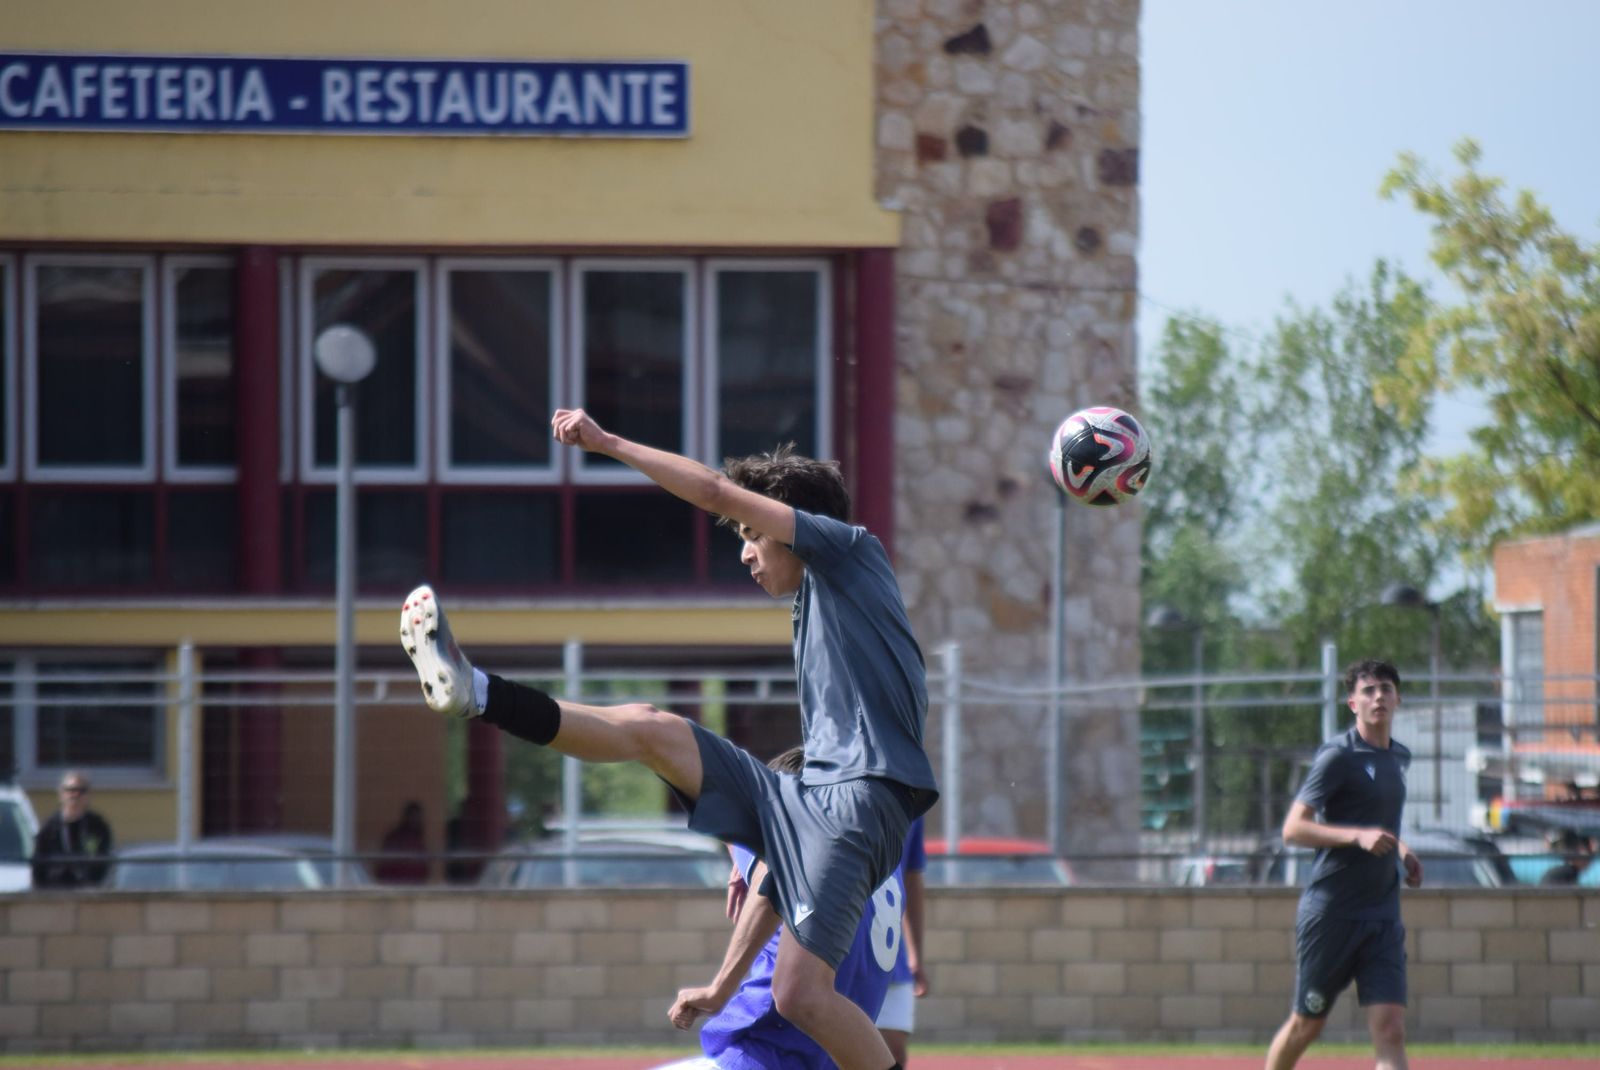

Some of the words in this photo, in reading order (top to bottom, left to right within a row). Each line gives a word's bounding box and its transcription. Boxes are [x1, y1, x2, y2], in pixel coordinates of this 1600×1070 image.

[0, 63, 273, 121] CAFETERIA
[322, 70, 676, 125] RESTAURANTE
[871, 876, 902, 972] 8
